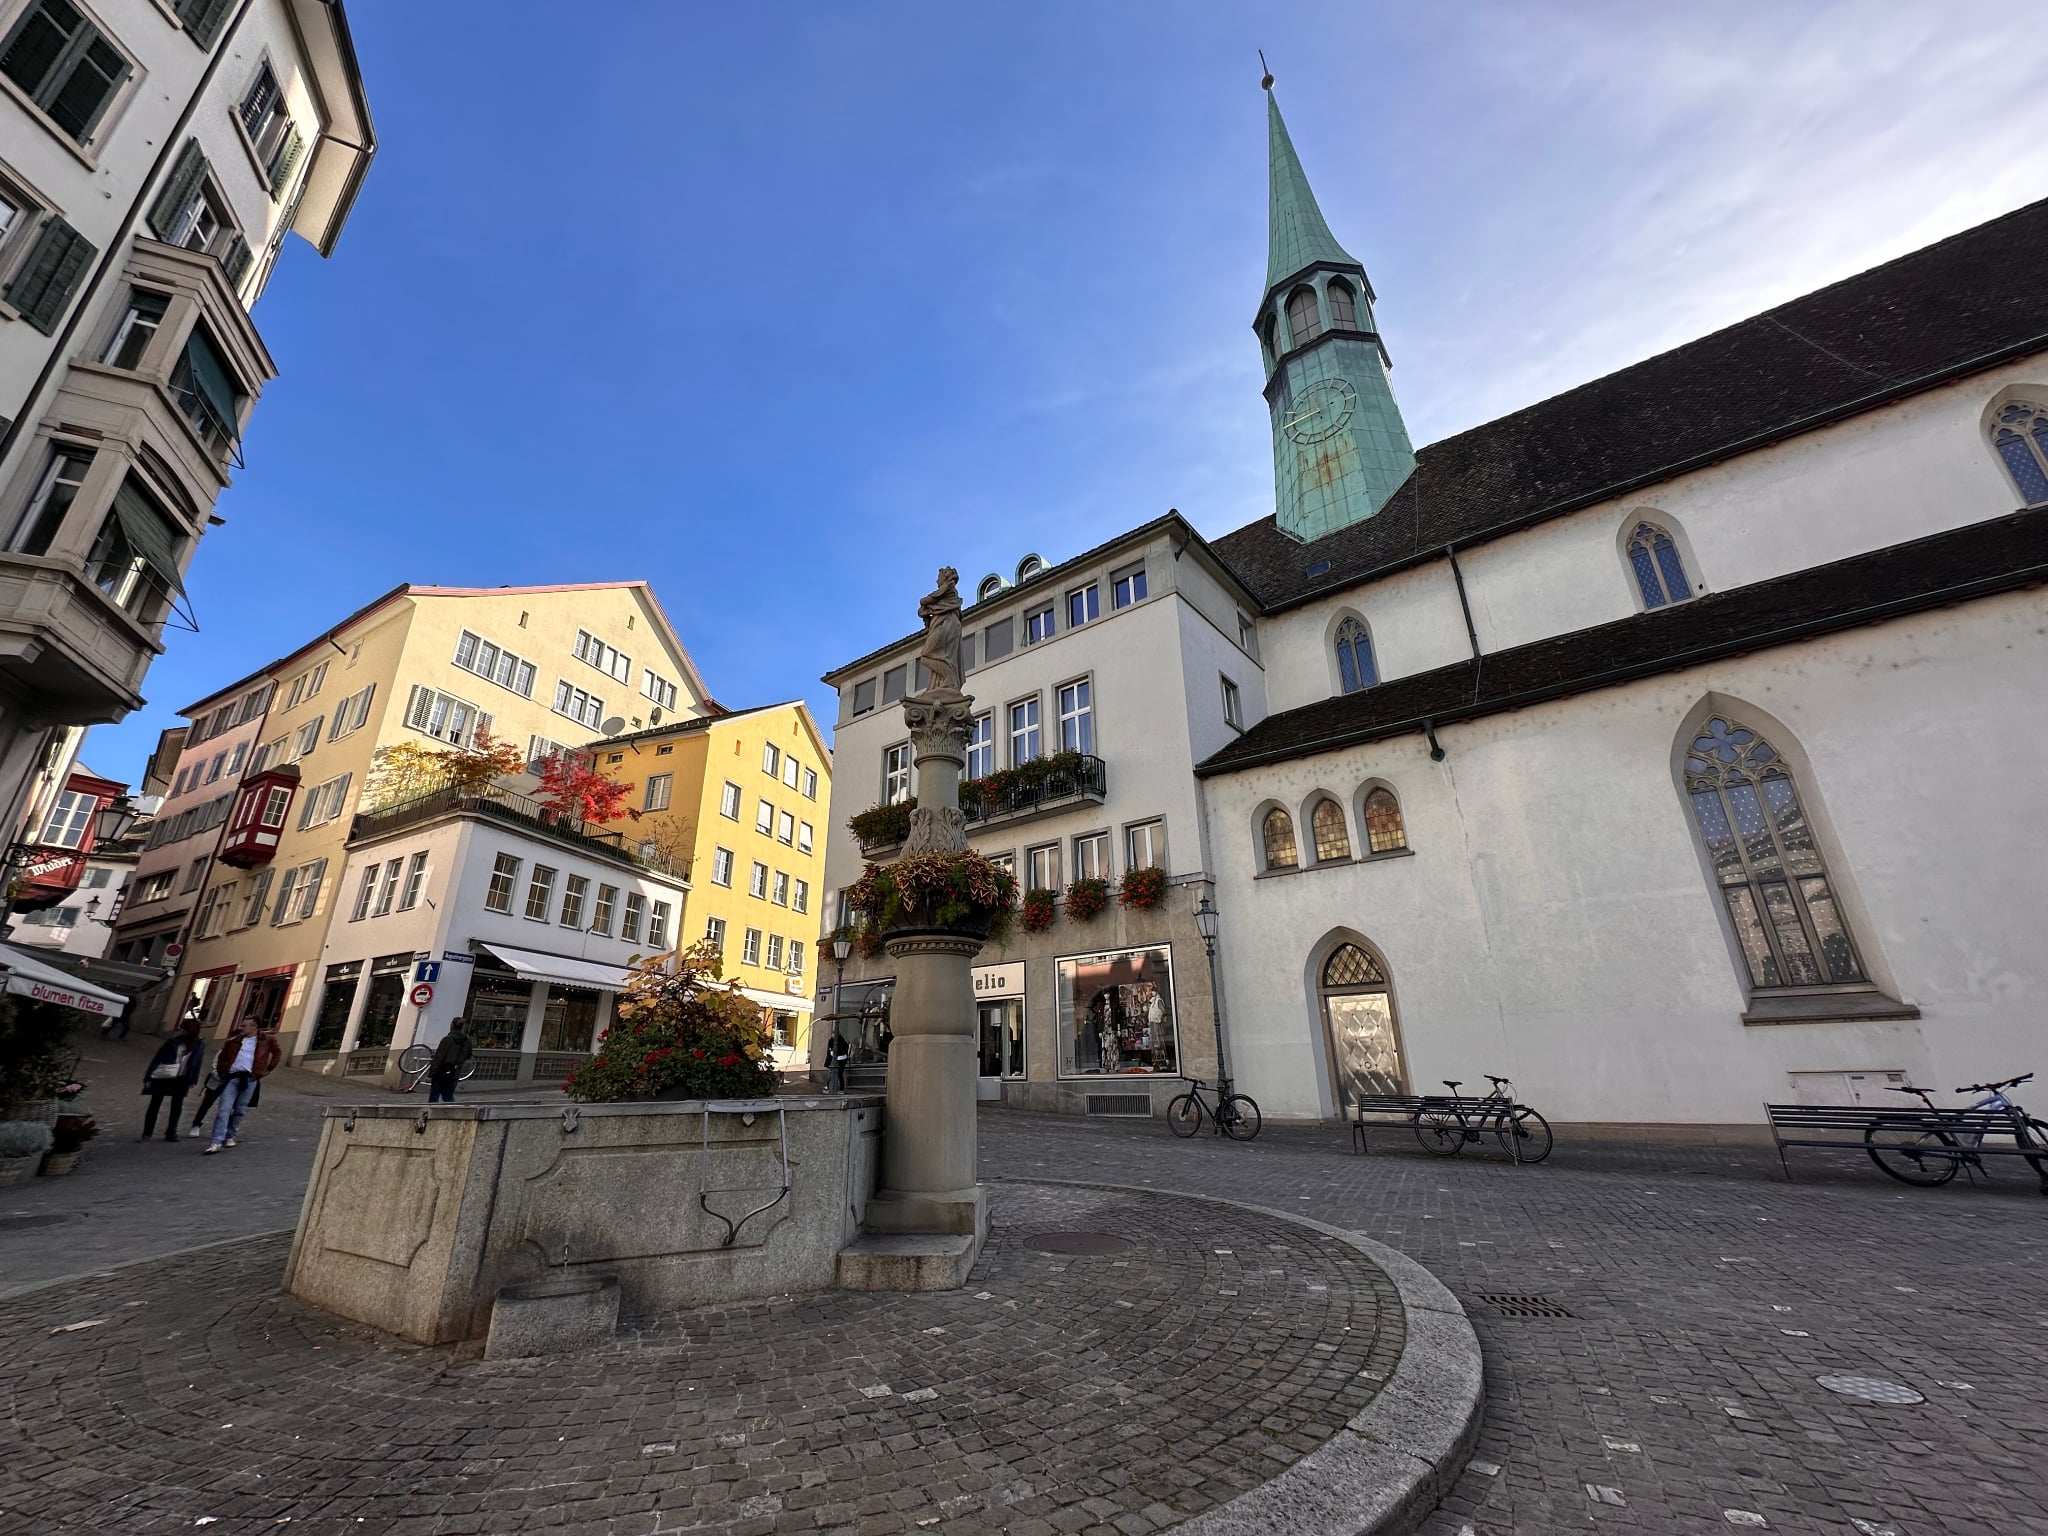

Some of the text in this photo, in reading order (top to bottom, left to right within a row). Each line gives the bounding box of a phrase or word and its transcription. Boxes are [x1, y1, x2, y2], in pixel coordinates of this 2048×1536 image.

[972, 974, 1005, 991] elio
[31, 984, 104, 1012] blumen fitze
